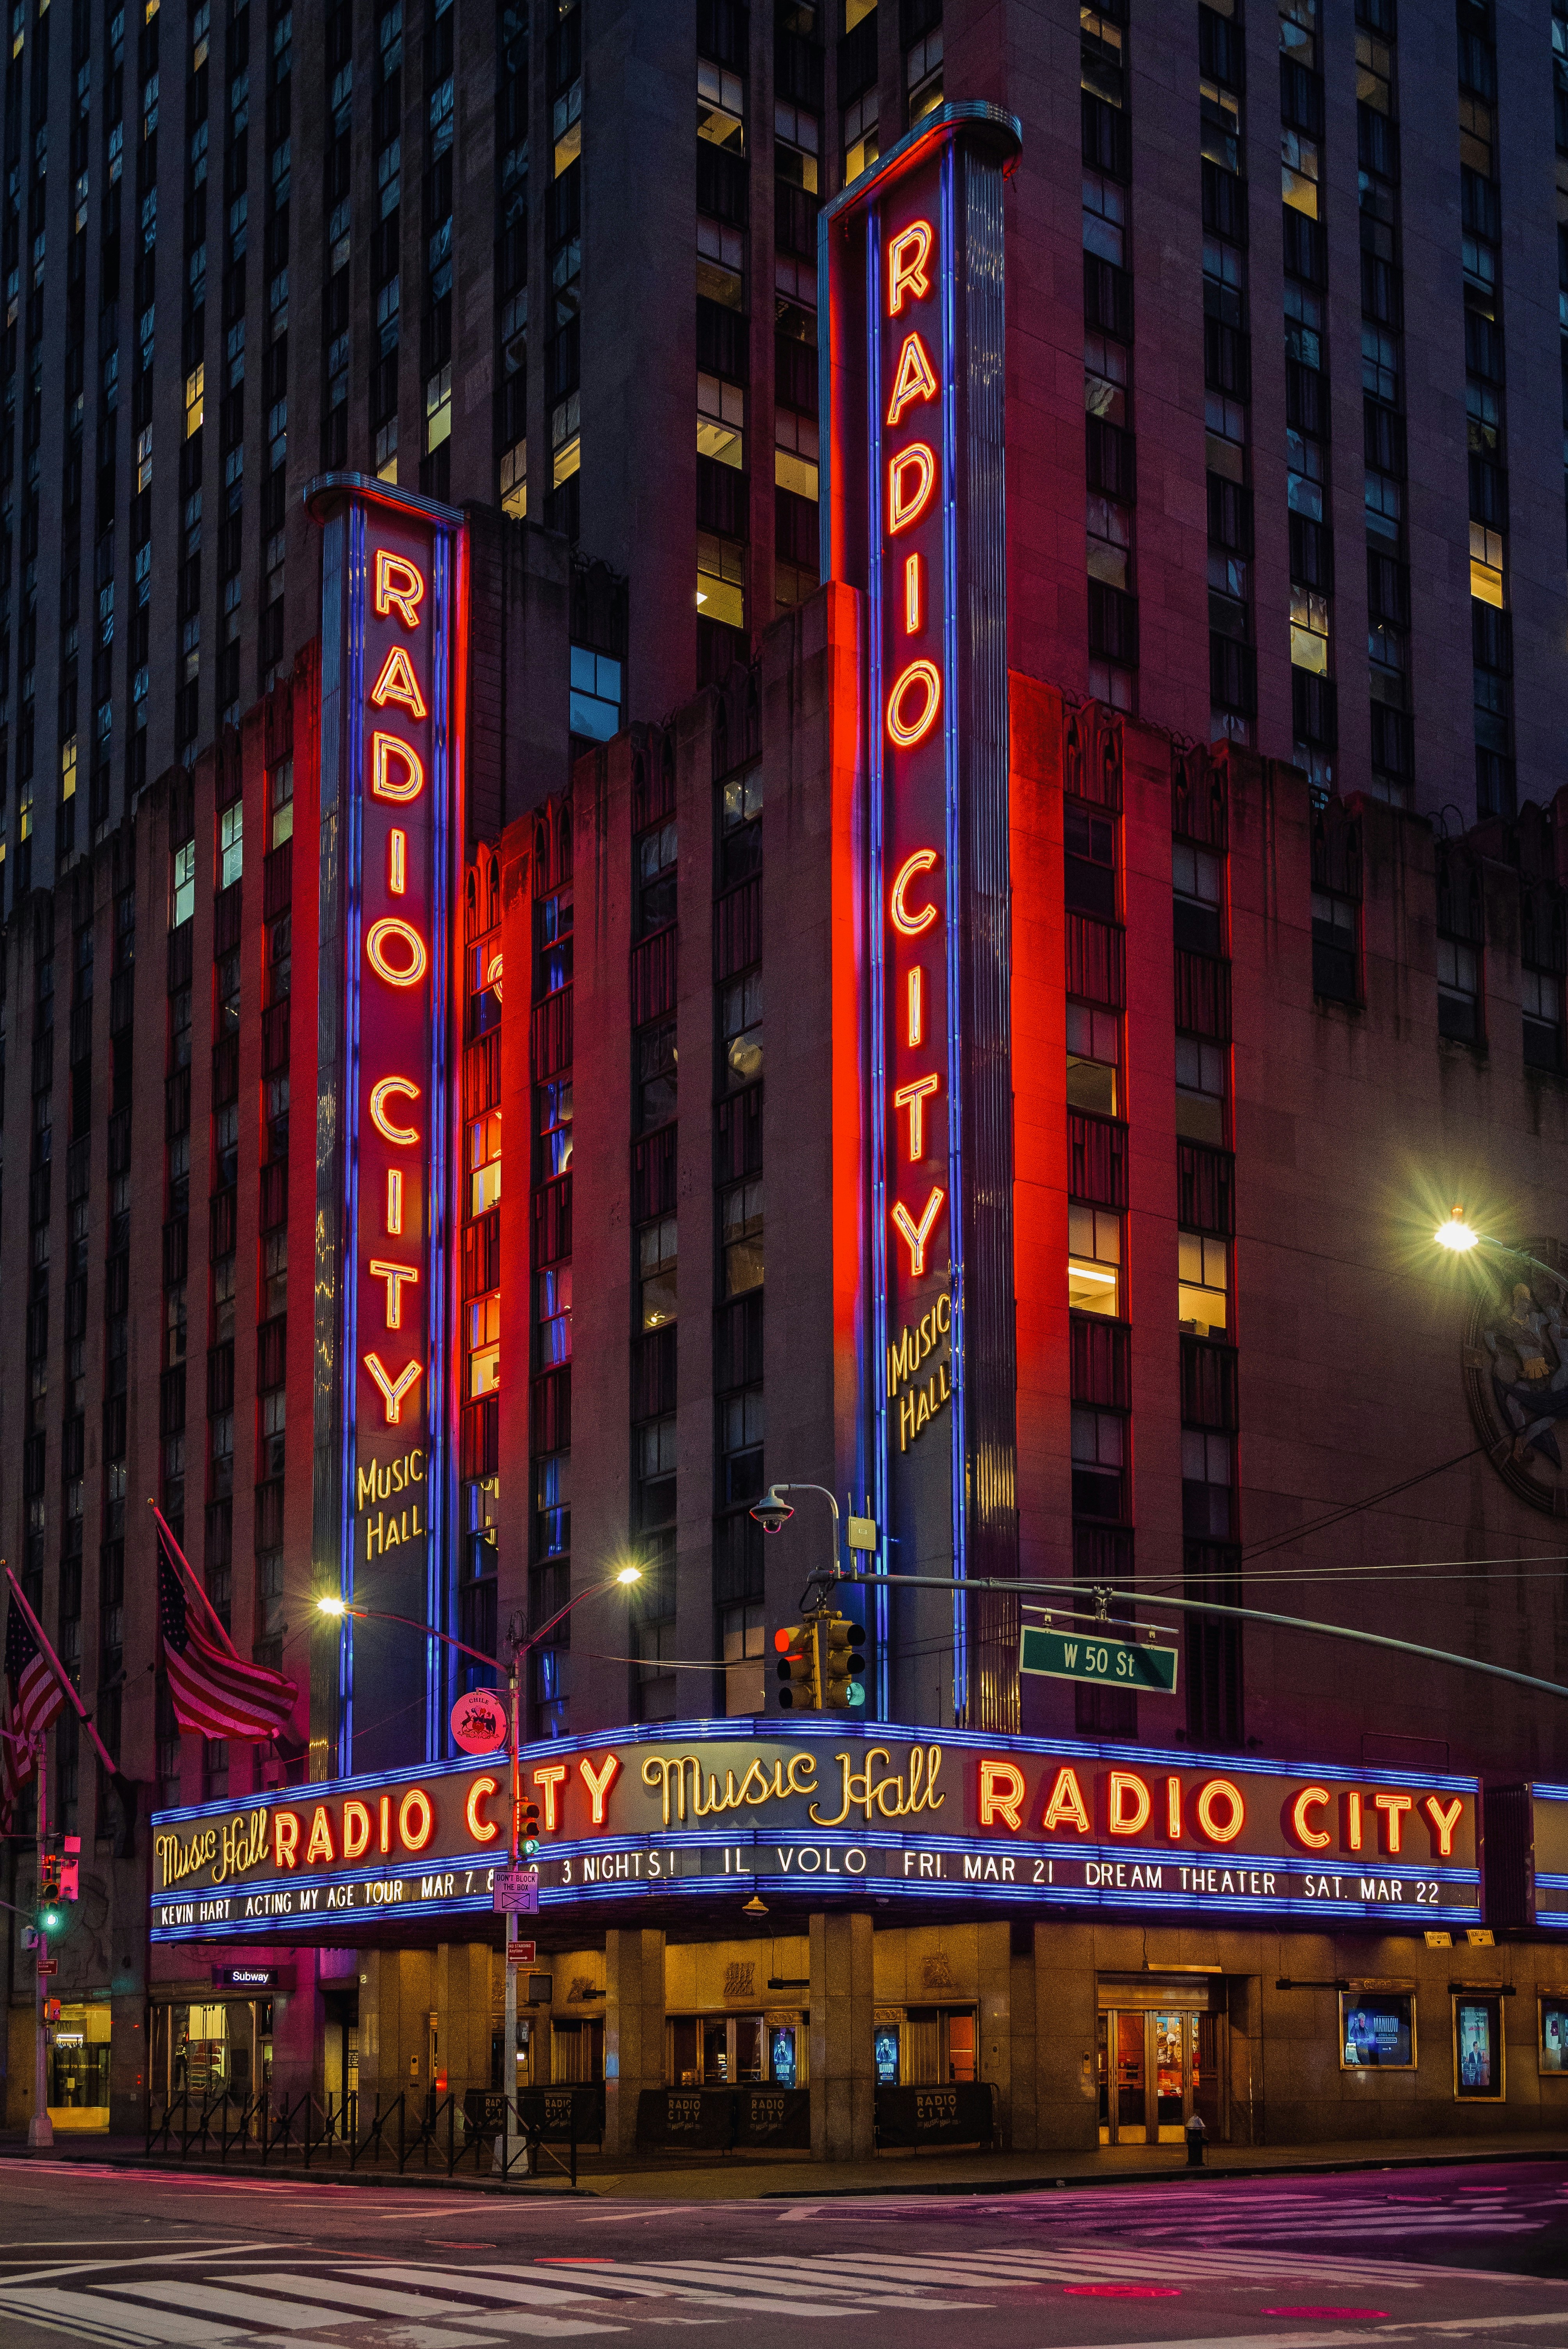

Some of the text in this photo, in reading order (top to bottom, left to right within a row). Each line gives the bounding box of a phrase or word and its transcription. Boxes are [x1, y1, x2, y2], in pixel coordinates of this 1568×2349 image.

[887, 220, 944, 1276] RADIO CITY
[365, 550, 426, 1423] RADIO CITY
[892, 1293, 950, 1396] MUSIC
[900, 1365, 950, 1452] HALL
[358, 1449, 423, 1511] MUSIC
[367, 1505, 423, 1560] HALL
[1064, 1643, 1135, 1677] W 50 St
[642, 1744, 946, 1826] Music Hall
[156, 1754, 620, 1887] Music Hall RADIO CTY
[980, 1759, 1463, 1856] RADIO CITY
[562, 1862, 572, 1884] 3
[724, 1847, 1053, 1884] IL VOLO FRI. MAR 21
[1086, 1862, 1439, 1904] DREAM THEATER SAT. MAR 22
[161, 1904, 193, 1925] KEVIN
[200, 1899, 231, 1920] HART
[246, 1893, 292, 1917] ACTING
[301, 1889, 318, 1911] MY
[327, 1886, 354, 1908] AGE
[365, 1880, 403, 1903] TOUR
[422, 1874, 454, 1898] MAR
[232, 1971, 269, 1983] Subway
[1373, 2018, 1399, 2032] MANILOW
[668, 2099, 700, 2110] RADIO
[668, 2110, 700, 2121] CITY
[751, 2099, 784, 2110] RADIO
[751, 2110, 784, 2121] CITY
[916, 2095, 957, 2107] RADIO
[917, 2106, 957, 2118] CITY
